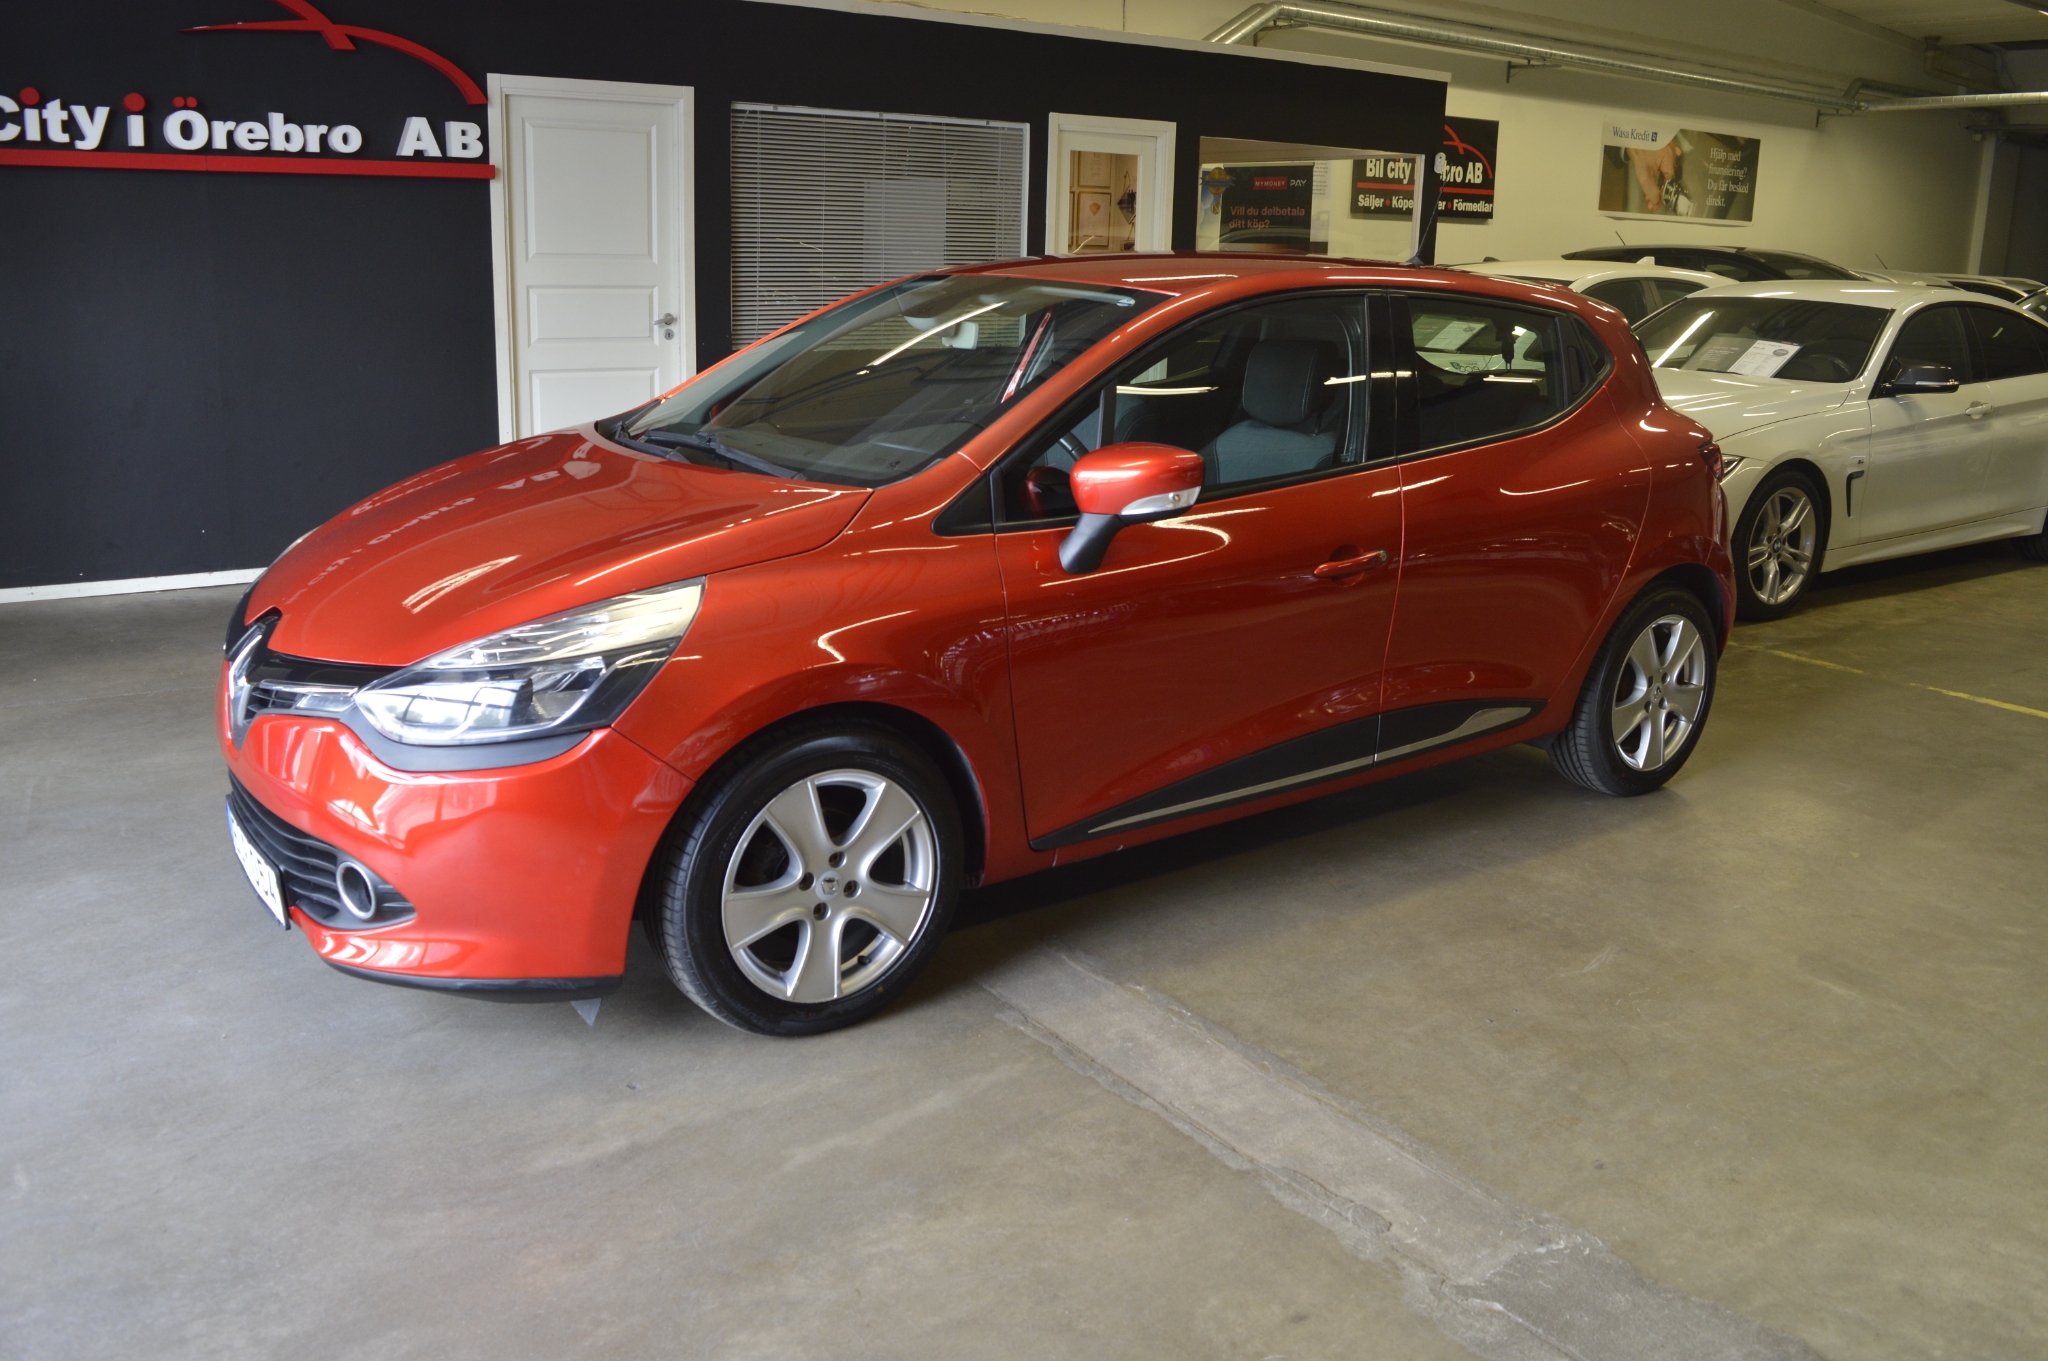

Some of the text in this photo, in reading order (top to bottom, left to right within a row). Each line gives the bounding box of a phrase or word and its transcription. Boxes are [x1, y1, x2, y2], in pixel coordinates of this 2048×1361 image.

[123, 92, 145, 147] i
[163, 96, 362, 154] Örebro
[396, 117, 484, 158] AB
[1612, 126, 1650, 142] Wasa Kredit
[1710, 147, 1742, 163] Hjälp med
[1366, 158, 1385, 178] Bil
[1387, 157, 1412, 185] city
[1465, 161, 1483, 184] AB
[1708, 163, 1748, 180] finansiering?
[1254, 179, 1307, 188] MYMONEY PAY
[1707, 178, 1718, 190] Du
[1728, 181, 1750, 193] besked
[1357, 194, 1385, 210] Säljer
[1391, 196, 1414, 211] Köpe
[1453, 199, 1494, 213] Förmedlar
[1705, 194, 1726, 207] direkt.
[1230, 206, 1305, 216] Vill du delbetala
[1228, 219, 1270, 231] ditt köp?
